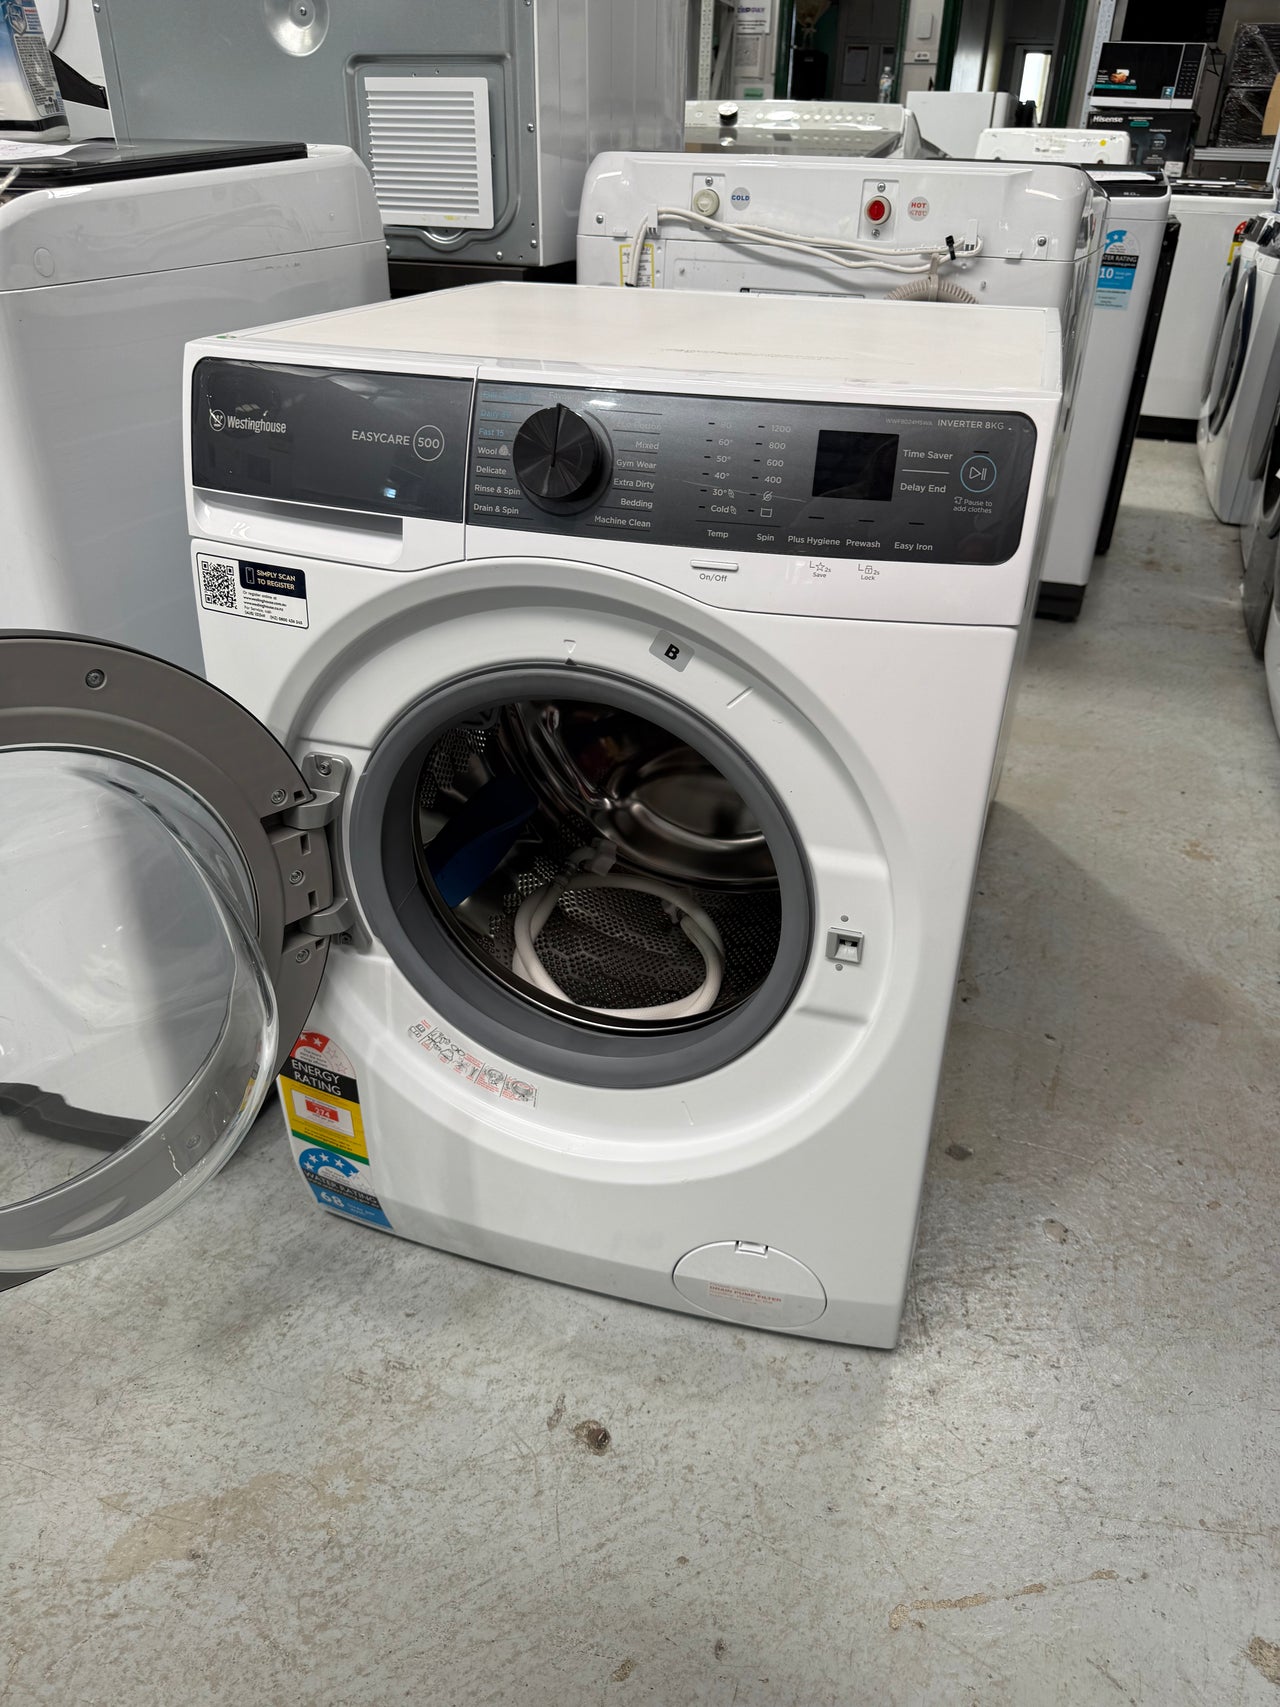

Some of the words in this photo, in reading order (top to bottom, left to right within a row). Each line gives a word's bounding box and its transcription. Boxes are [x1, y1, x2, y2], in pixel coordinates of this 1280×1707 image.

[1093, 115, 1123, 123] Hisense
[1114, 254, 1138, 263] RATING
[1099, 268, 1114, 279] 10
[227, 415, 287, 434] Westinghouse
[771, 425, 792, 433] 1200
[938, 420, 983, 429] INVERTER
[985, 422, 1004, 430] 8KG
[352, 430, 410, 446] EASYCARE
[417, 438, 440, 449] 500
[635, 440, 660, 450] Mixed
[768, 442, 786, 450] 800
[478, 446, 498, 456] Wool
[903, 450, 926, 459] Time
[928, 451, 954, 460] Saver
[616, 459, 634, 470] Gym
[636, 461, 657, 470] Wear
[766, 459, 784, 468] 600
[476, 466, 507, 476] Delicate
[614, 478, 634, 488] Extra
[636, 480, 655, 490] Dirty
[764, 476, 782, 484] 400
[474, 484, 494, 494] Rinse
[496, 486, 502, 494] &
[504, 486, 521, 497] Spin
[900, 482, 926, 494] Delay
[928, 484, 946, 494] End
[620, 498, 654, 510] Bedding
[964, 499, 983, 507] Pause
[473, 503, 494, 514] Drain
[495, 505, 502, 514] &
[503, 506, 520, 516] Spin
[710, 505, 730, 514] Cold
[967, 506, 992, 514] clothes
[594, 515, 627, 526] Machine
[629, 518, 652, 528] Clean
[708, 530, 729, 539] Temp
[756, 533, 775, 542] Spin
[788, 535, 805, 544] Plus
[806, 536, 841, 546] Hygiene
[846, 538, 881, 548] Prewash
[894, 542, 914, 552] Easy
[916, 542, 933, 552] Iron
[256, 570, 278, 579] SIMPLY
[278, 573, 296, 582] SCAN
[699, 573, 728, 583] On/Off
[266, 579, 295, 590] REGISTER
[664, 643, 680, 660] B
[292, 1059, 340, 1084] ENERGY
[294, 1071, 342, 1096] RATING
[304, 1170, 339, 1190] WATER
[340, 1186, 378, 1204] RATING
[320, 1192, 344, 1208] 68
